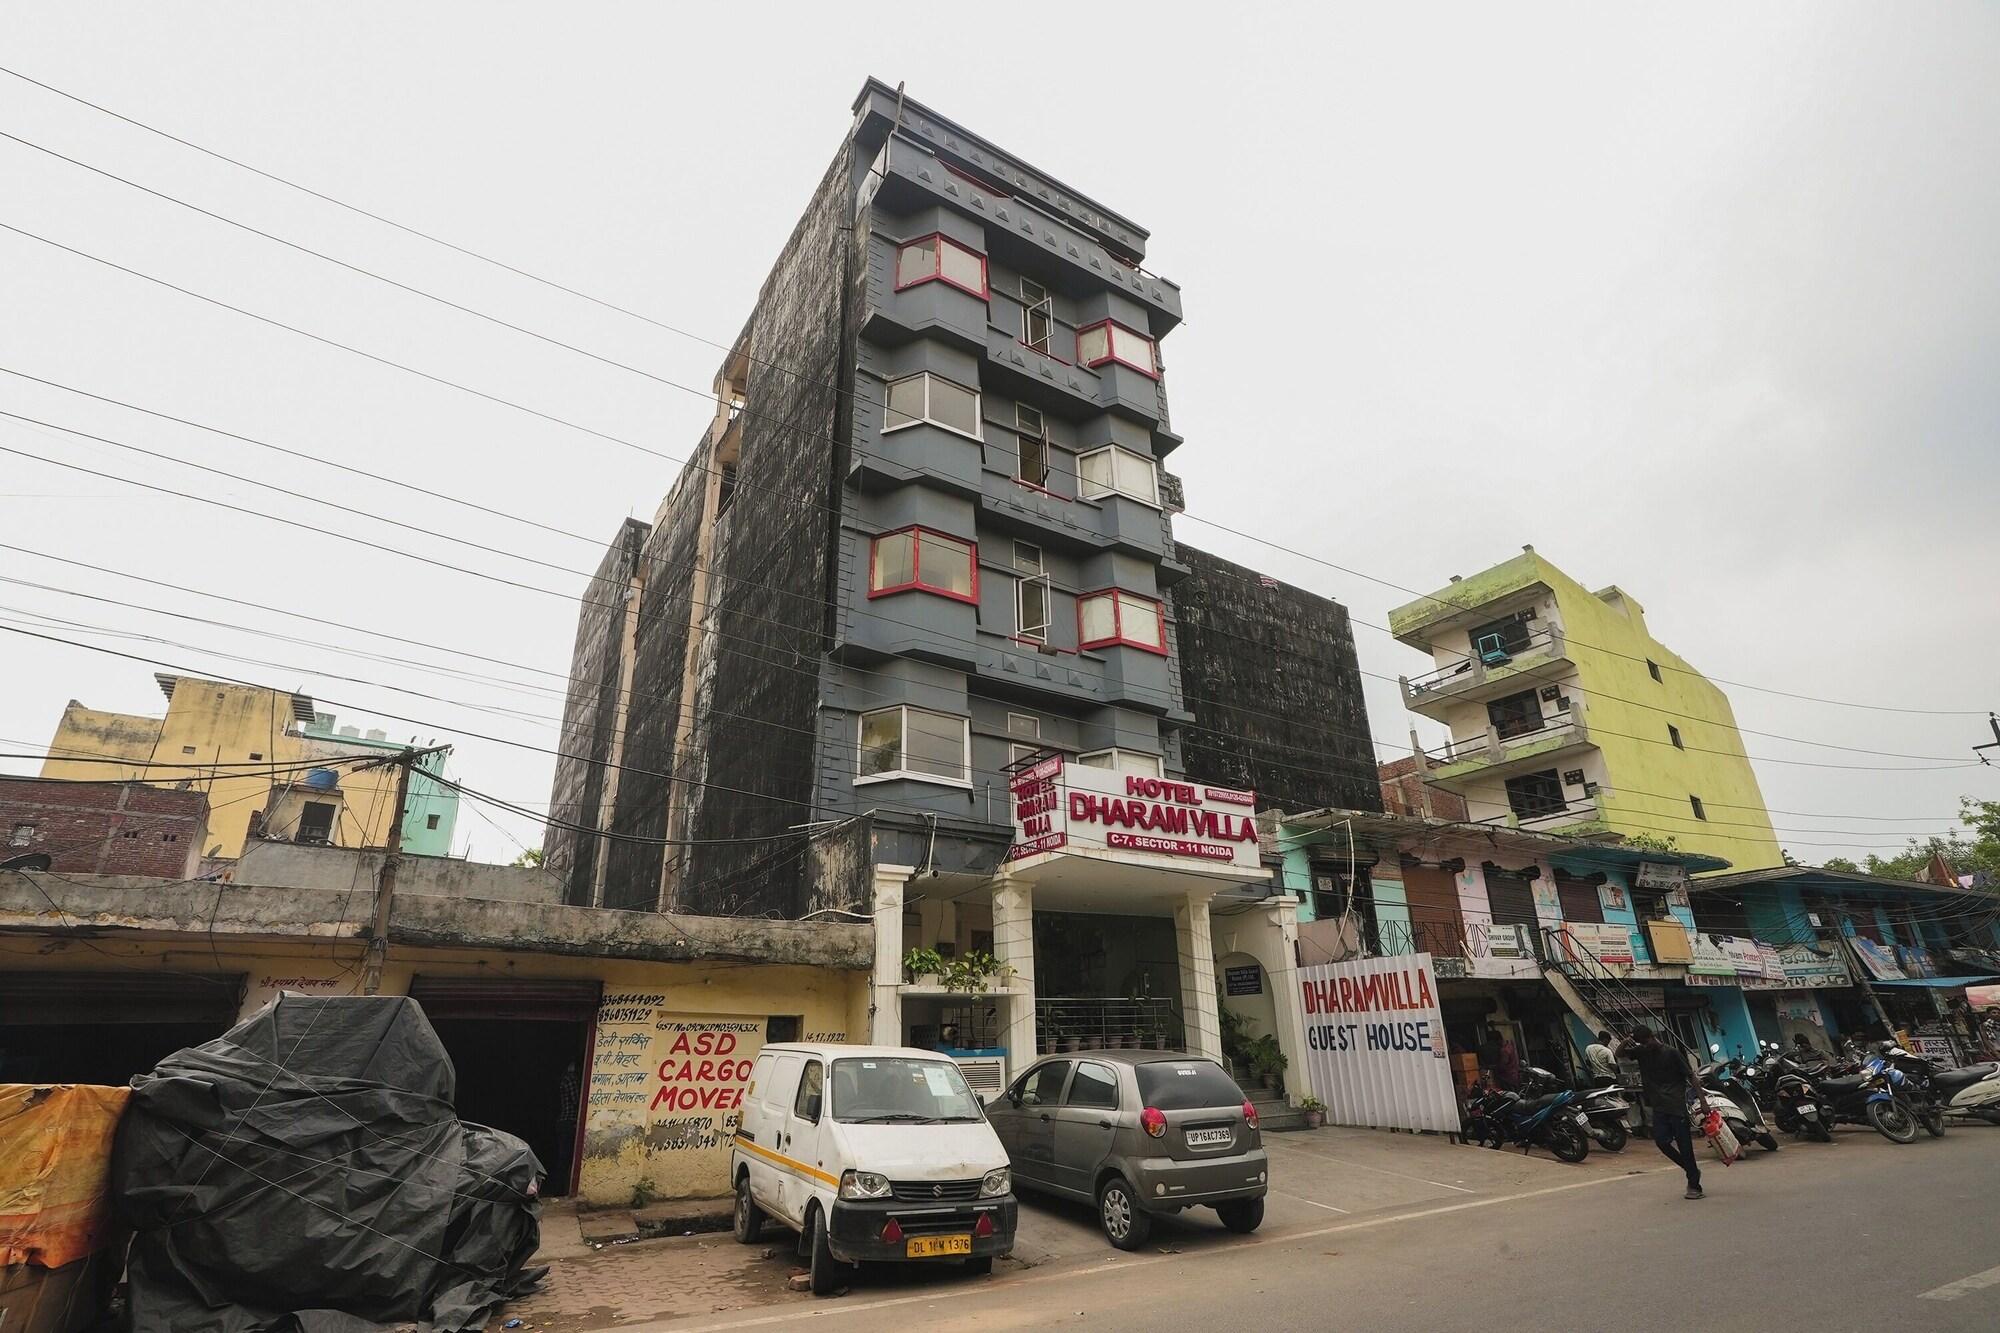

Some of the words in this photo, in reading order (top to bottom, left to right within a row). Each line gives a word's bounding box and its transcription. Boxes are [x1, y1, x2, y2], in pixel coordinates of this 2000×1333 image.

[1017, 778, 1055, 803] HOTEL
[1126, 776, 1202, 805] HOTEL
[1017, 791, 1057, 821] DHARAM
[1111, 834, 1133, 847] C-7,
[1135, 837, 1178, 851] SECTOR
[1186, 843, 1198, 853] 11
[1201, 845, 1232, 858] NOIDA
[669, 1032, 737, 1055] ASD
[1308, 1024, 1357, 1051] GUEST
[1366, 1021, 1432, 1052] HOUSE
[658, 1059, 753, 1082] CARGO
[914, 1241, 925, 1253] DL
[949, 1239, 969, 1250] 1376
